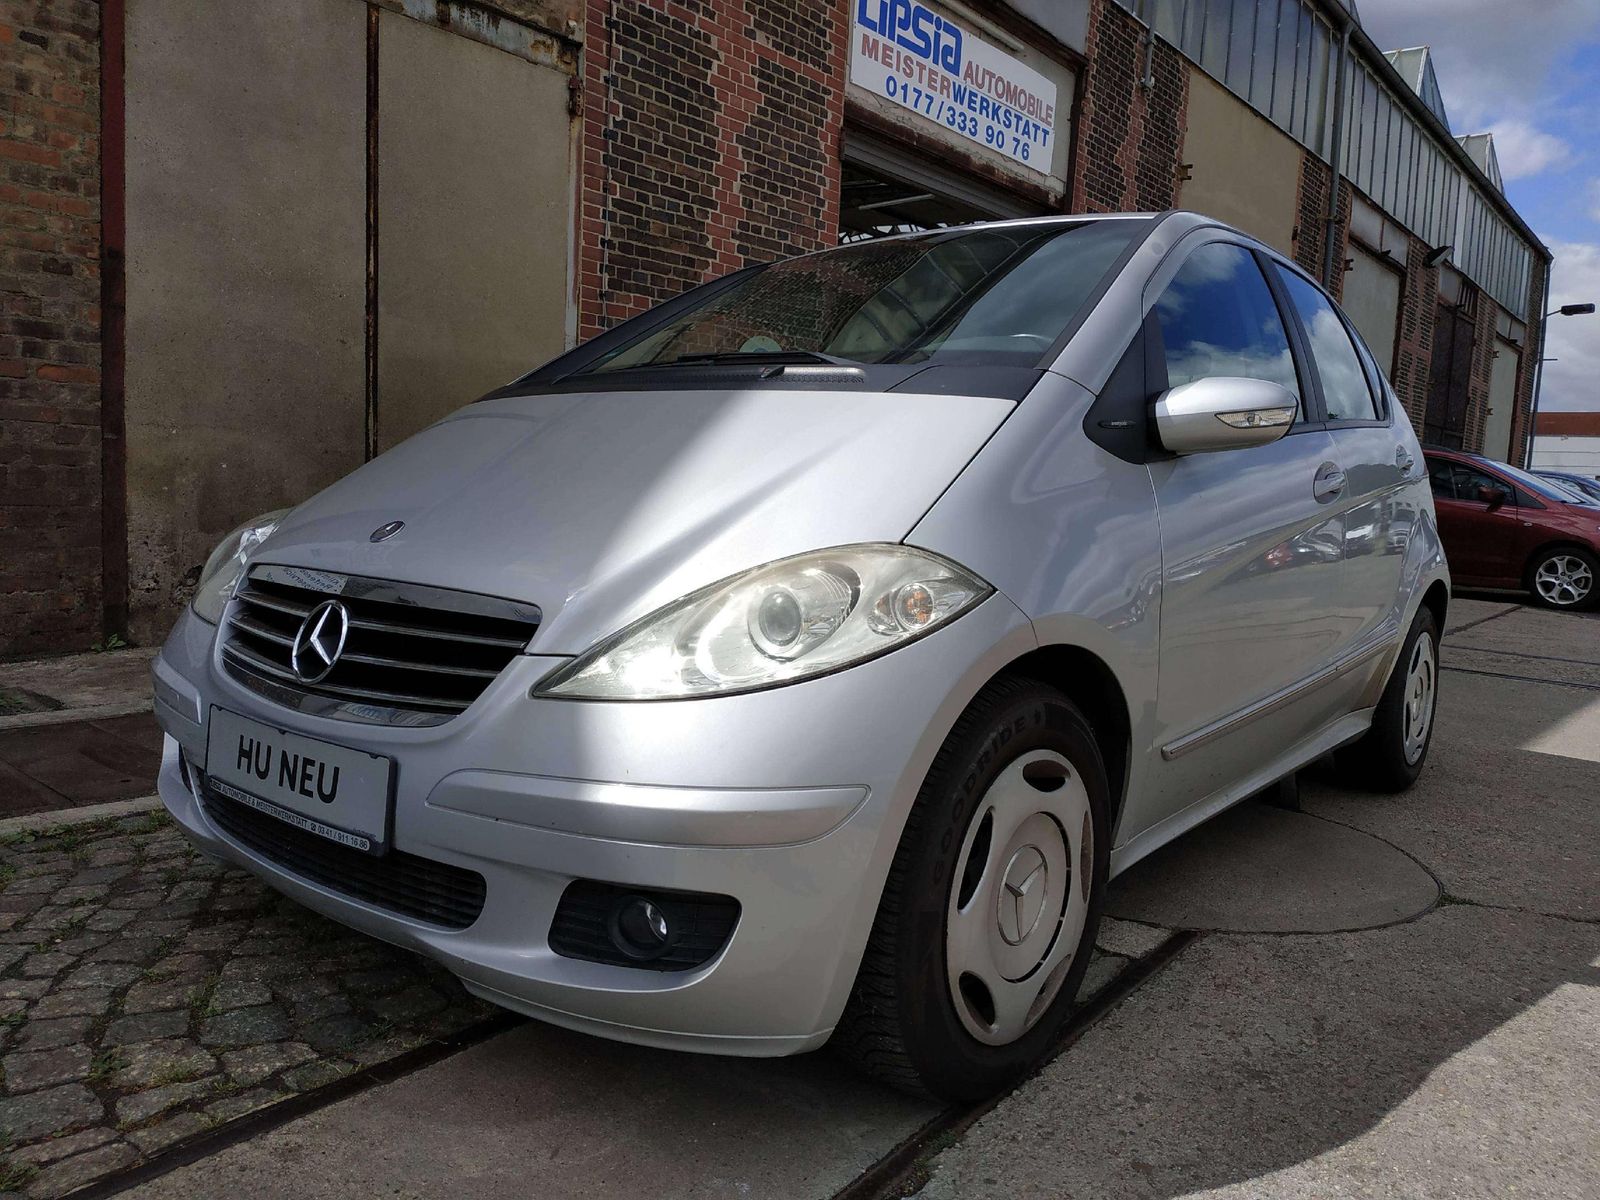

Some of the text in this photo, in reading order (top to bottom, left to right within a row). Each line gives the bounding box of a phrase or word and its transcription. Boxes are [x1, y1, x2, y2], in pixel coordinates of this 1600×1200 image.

[861, 33, 1050, 147] MEISTERWERKSTATT
[963, 61, 1053, 127] AUTOMOBILE
[986, 126, 1005, 149] 90
[1012, 138, 1030, 161] 76
[237, 734, 340, 804] HU NEU
[933, 716, 1026, 885] GOODRIDE
[222, 782, 251, 803] AUTOMOBILE
[256, 801, 308, 828] MEISTERWERKSTATT
